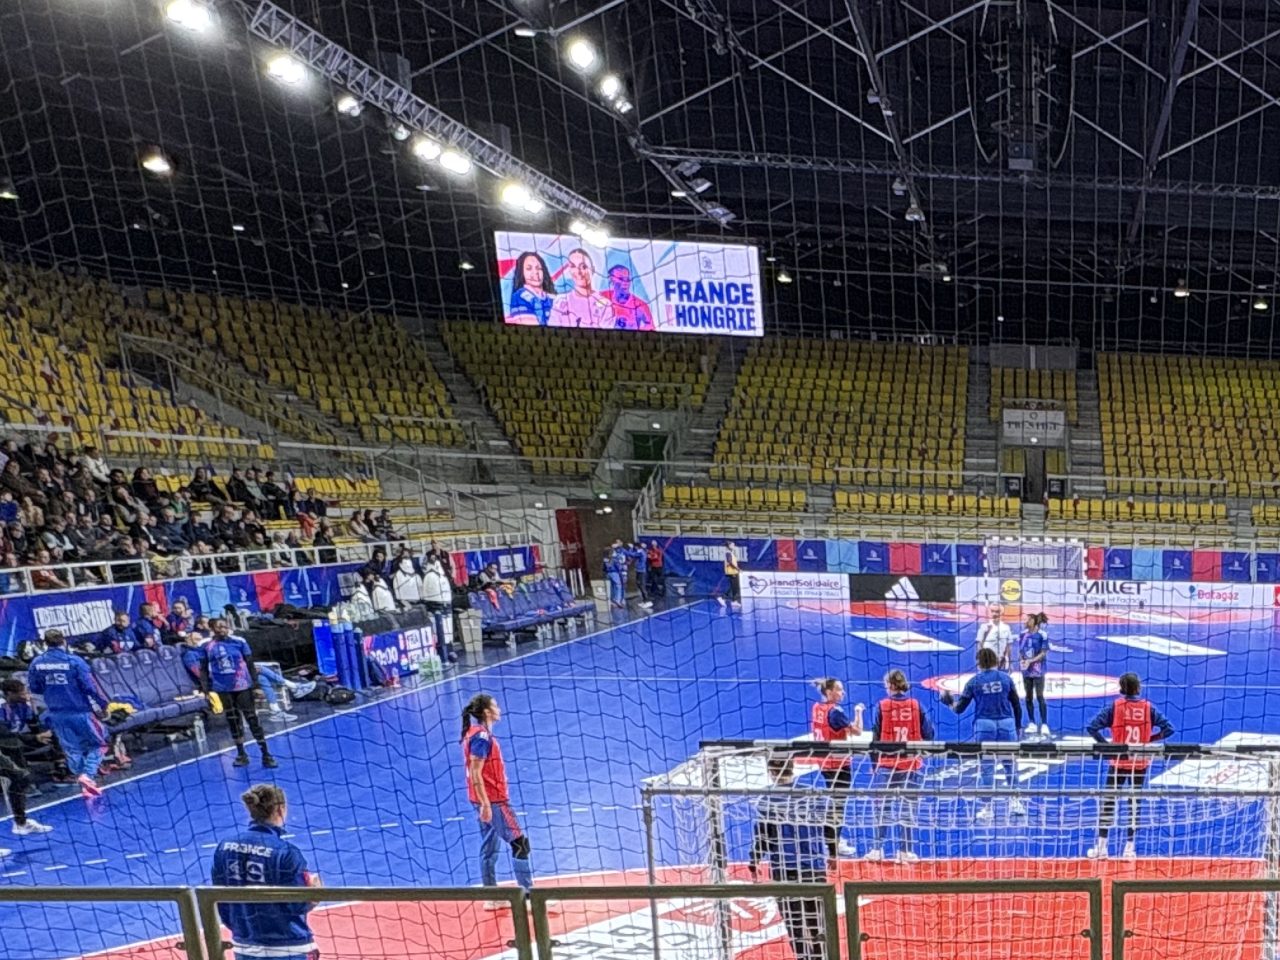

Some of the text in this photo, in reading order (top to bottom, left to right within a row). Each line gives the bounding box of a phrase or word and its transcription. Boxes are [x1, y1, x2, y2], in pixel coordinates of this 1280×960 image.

[664, 279, 755, 306] FRANCE
[675, 304, 756, 331] HONGRIE
[1077, 581, 1147, 595] MILLET
